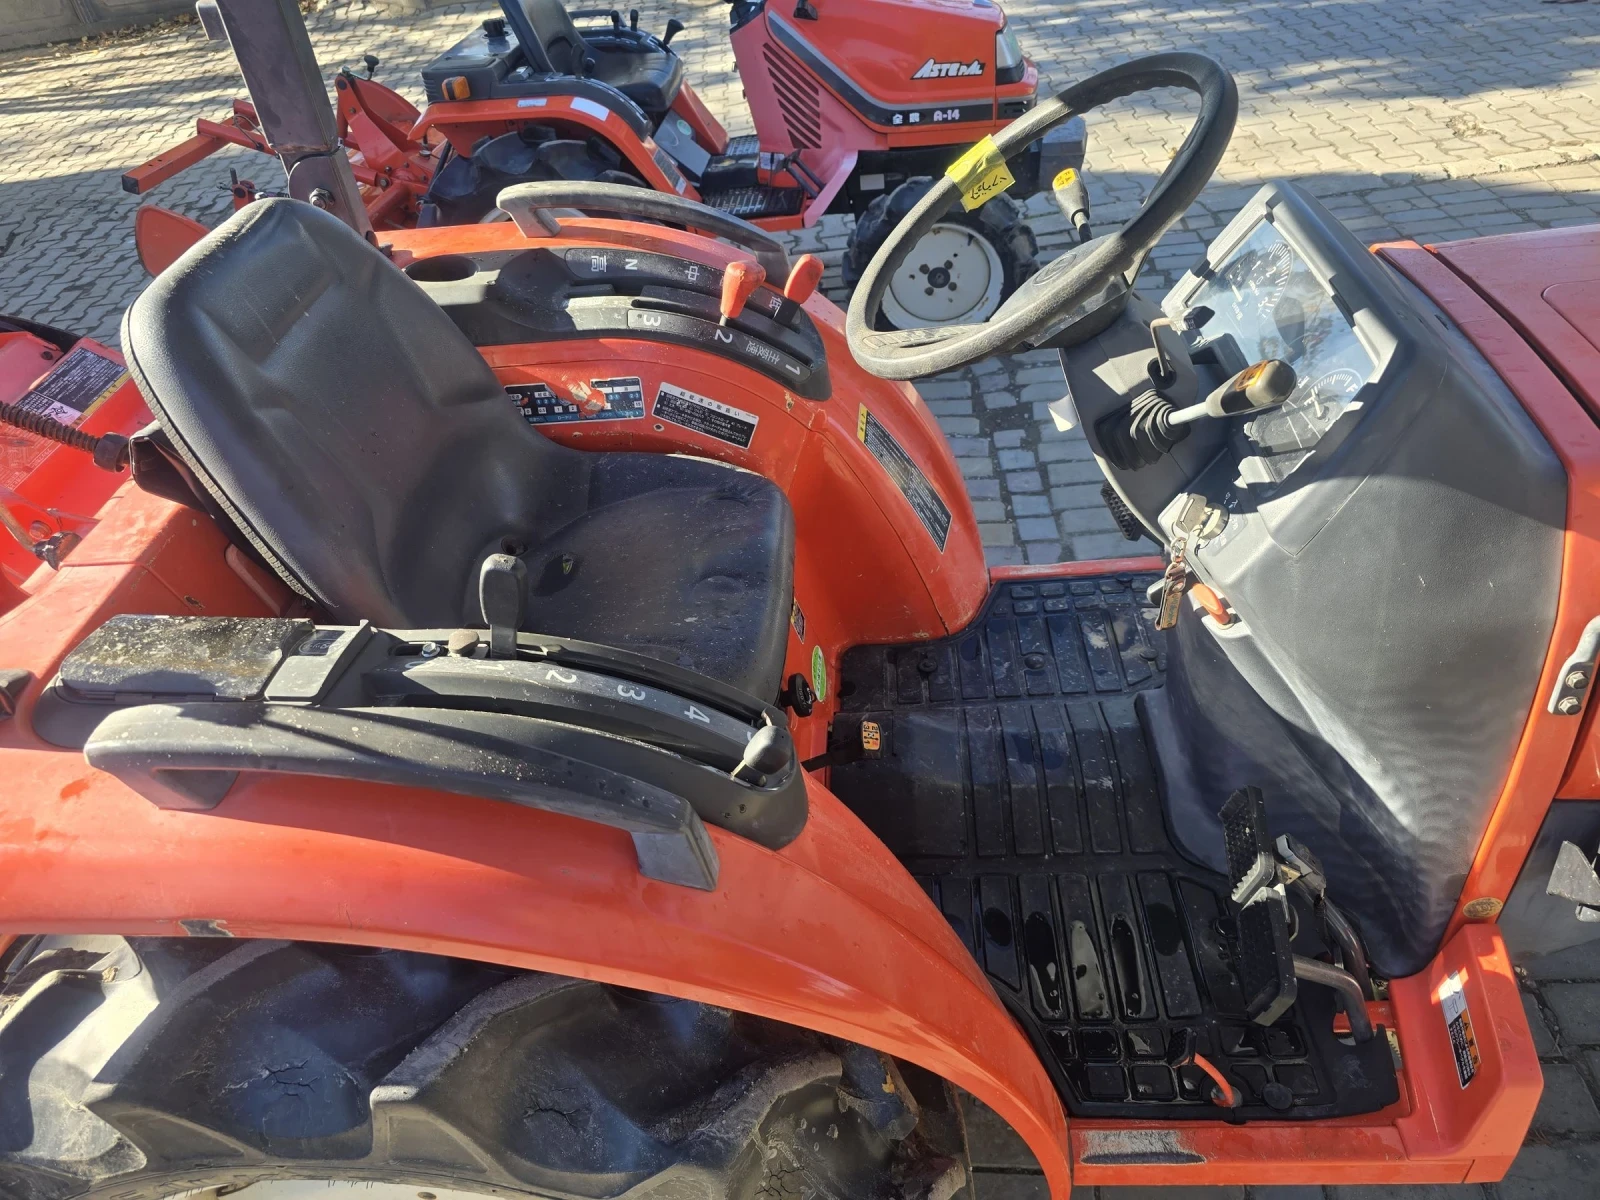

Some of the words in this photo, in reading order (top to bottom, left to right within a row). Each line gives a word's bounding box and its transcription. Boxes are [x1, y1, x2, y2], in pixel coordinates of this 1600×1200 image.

[933, 109, 961, 121] A-14
[591, 255, 607, 272] 高
[625, 258, 638, 270] N
[685, 265, 700, 281] 中
[643, 313, 661, 327] 3
[714, 328, 733, 344] 2
[746, 340, 781, 366] 主変速
[785, 363, 801, 376] 1
[545, 670, 576, 684] 2
[617, 684, 646, 701] 3
[684, 705, 711, 724] 4
